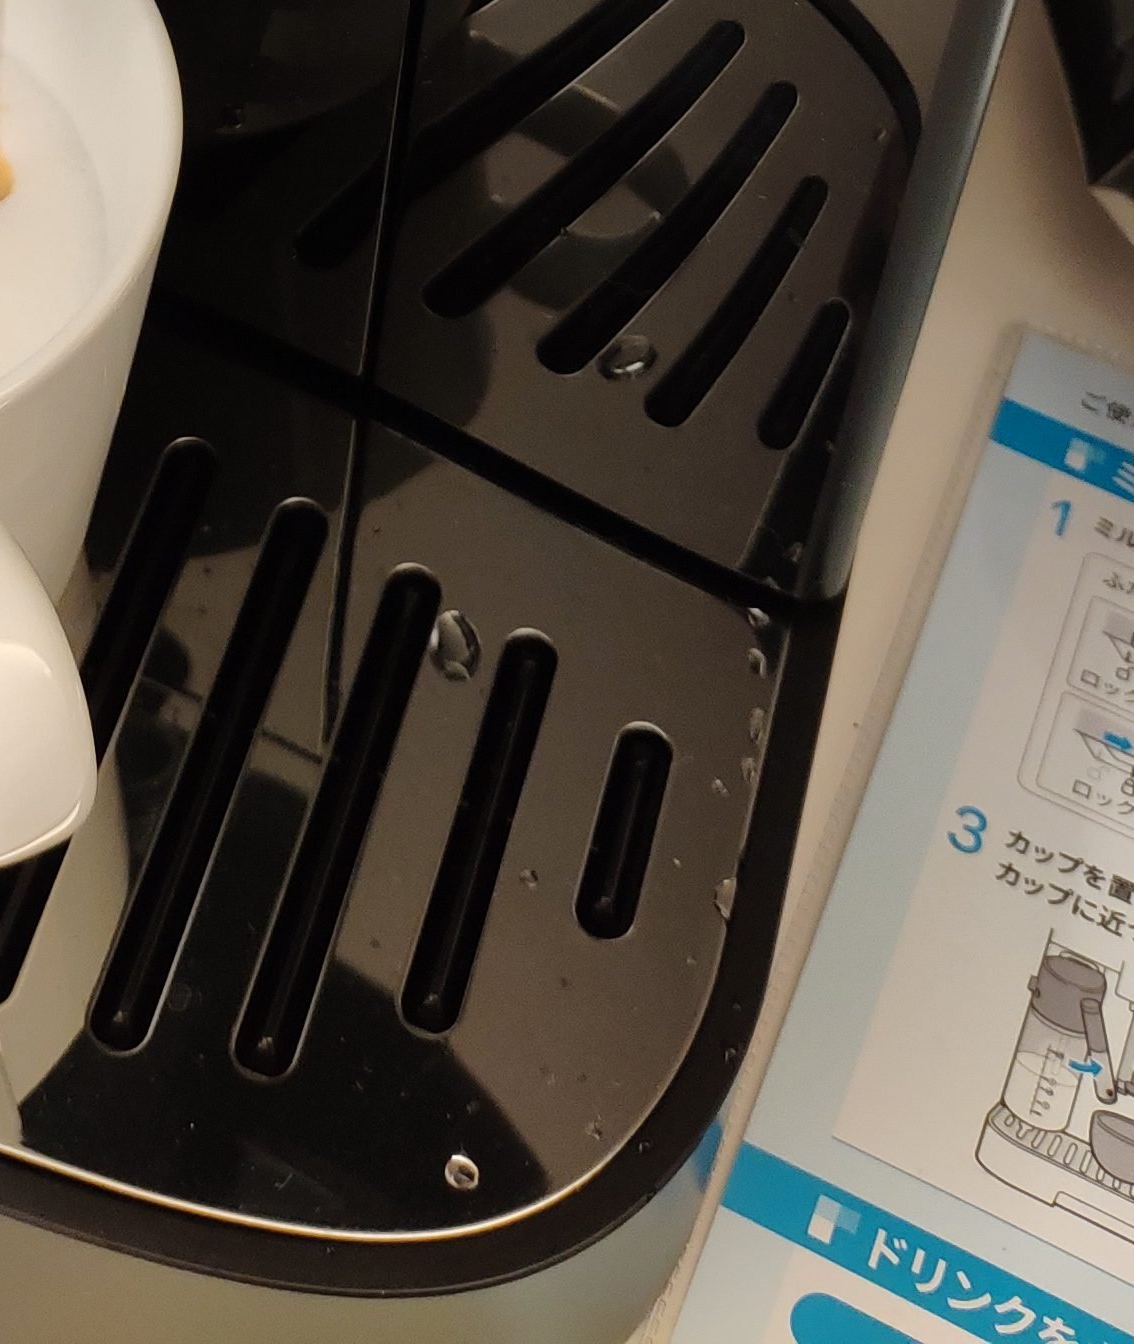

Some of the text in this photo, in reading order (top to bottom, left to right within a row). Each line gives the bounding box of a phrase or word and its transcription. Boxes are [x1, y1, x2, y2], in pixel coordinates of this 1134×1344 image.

[1051, 500, 1070, 536] 1
[947, 805, 988, 854] 3
[995, 861, 1134, 941] カップに近
